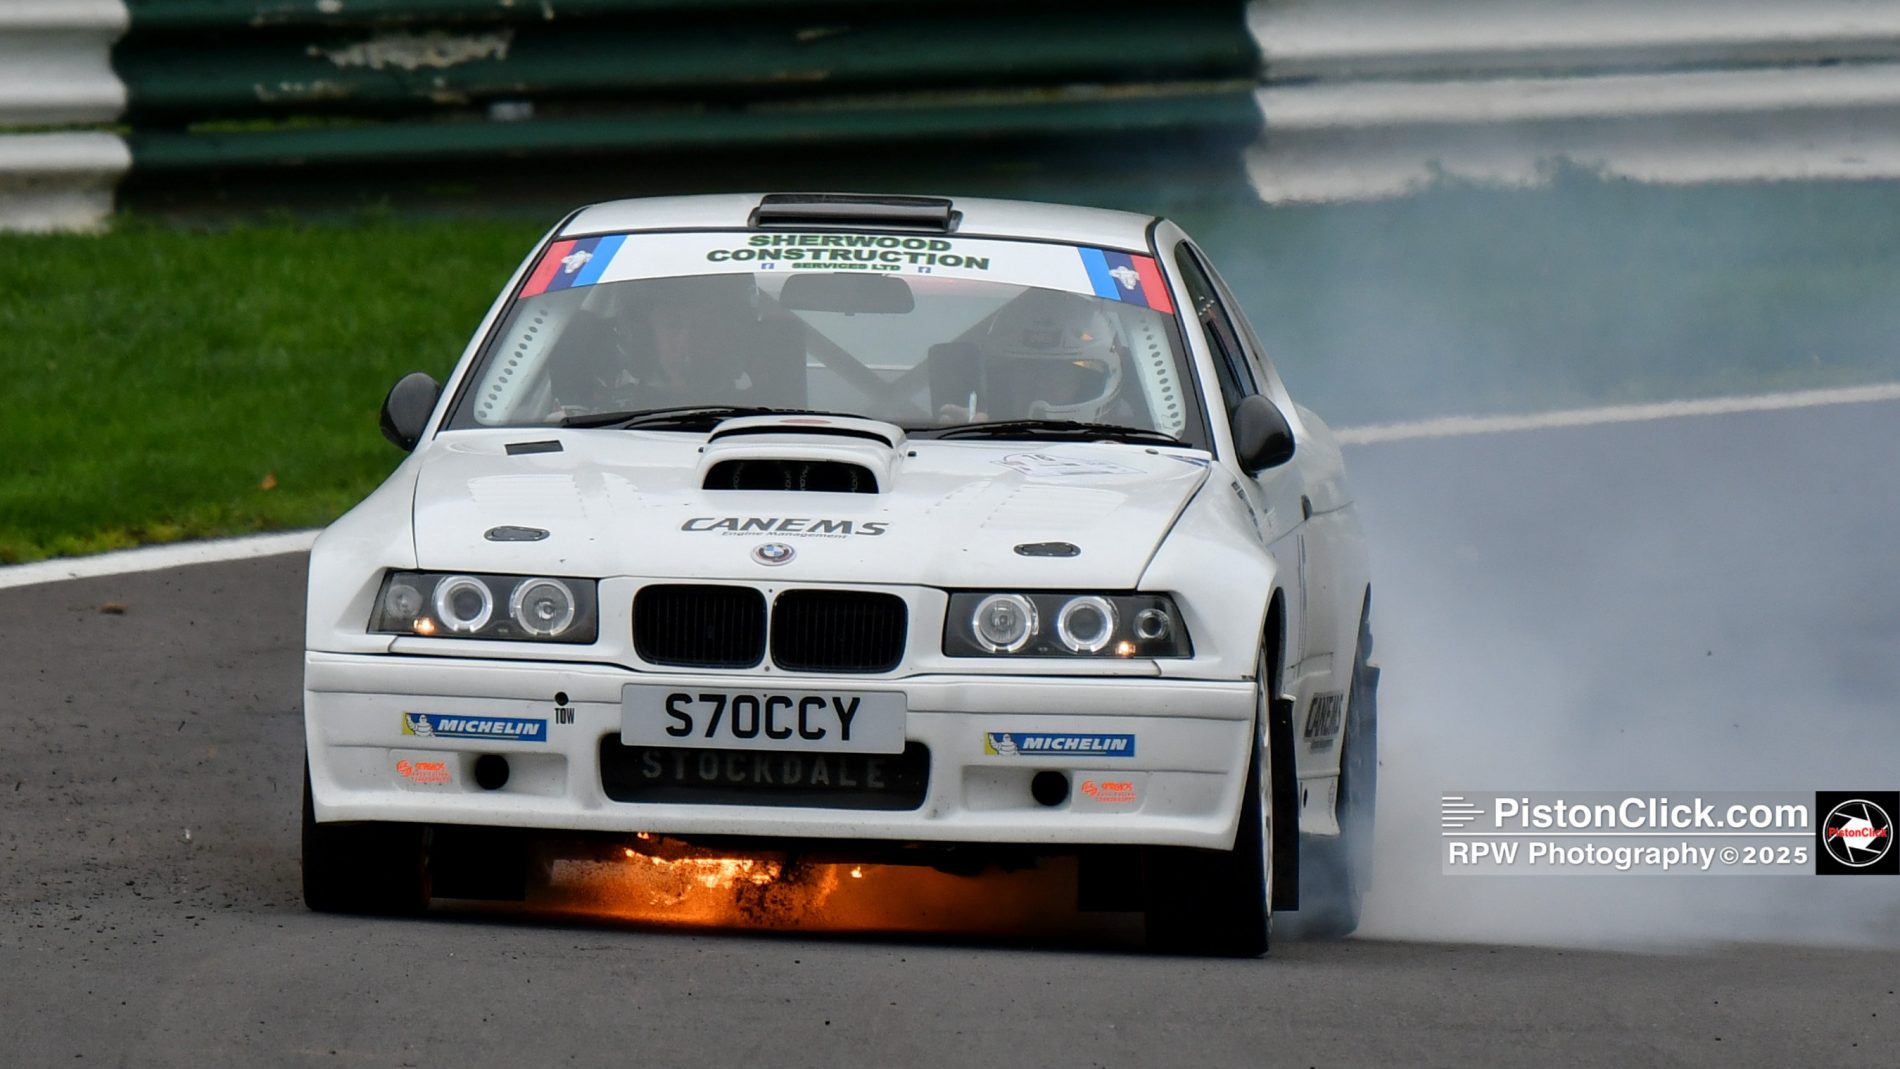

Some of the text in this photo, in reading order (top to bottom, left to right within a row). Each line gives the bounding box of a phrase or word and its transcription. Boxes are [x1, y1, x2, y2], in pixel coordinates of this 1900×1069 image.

[748, 235, 952, 252] SHERWOOD
[706, 248, 990, 270] CONSTRUCTION
[792, 261, 901, 271] SERVICES LTD
[681, 517, 890, 537] CANEMS
[766, 531, 847, 540] Management
[554, 707, 575, 725] TOW
[438, 718, 541, 736] MICHELIN
[1022, 737, 1128, 751] MICHELIN
[642, 750, 888, 790] STOCKDALE
